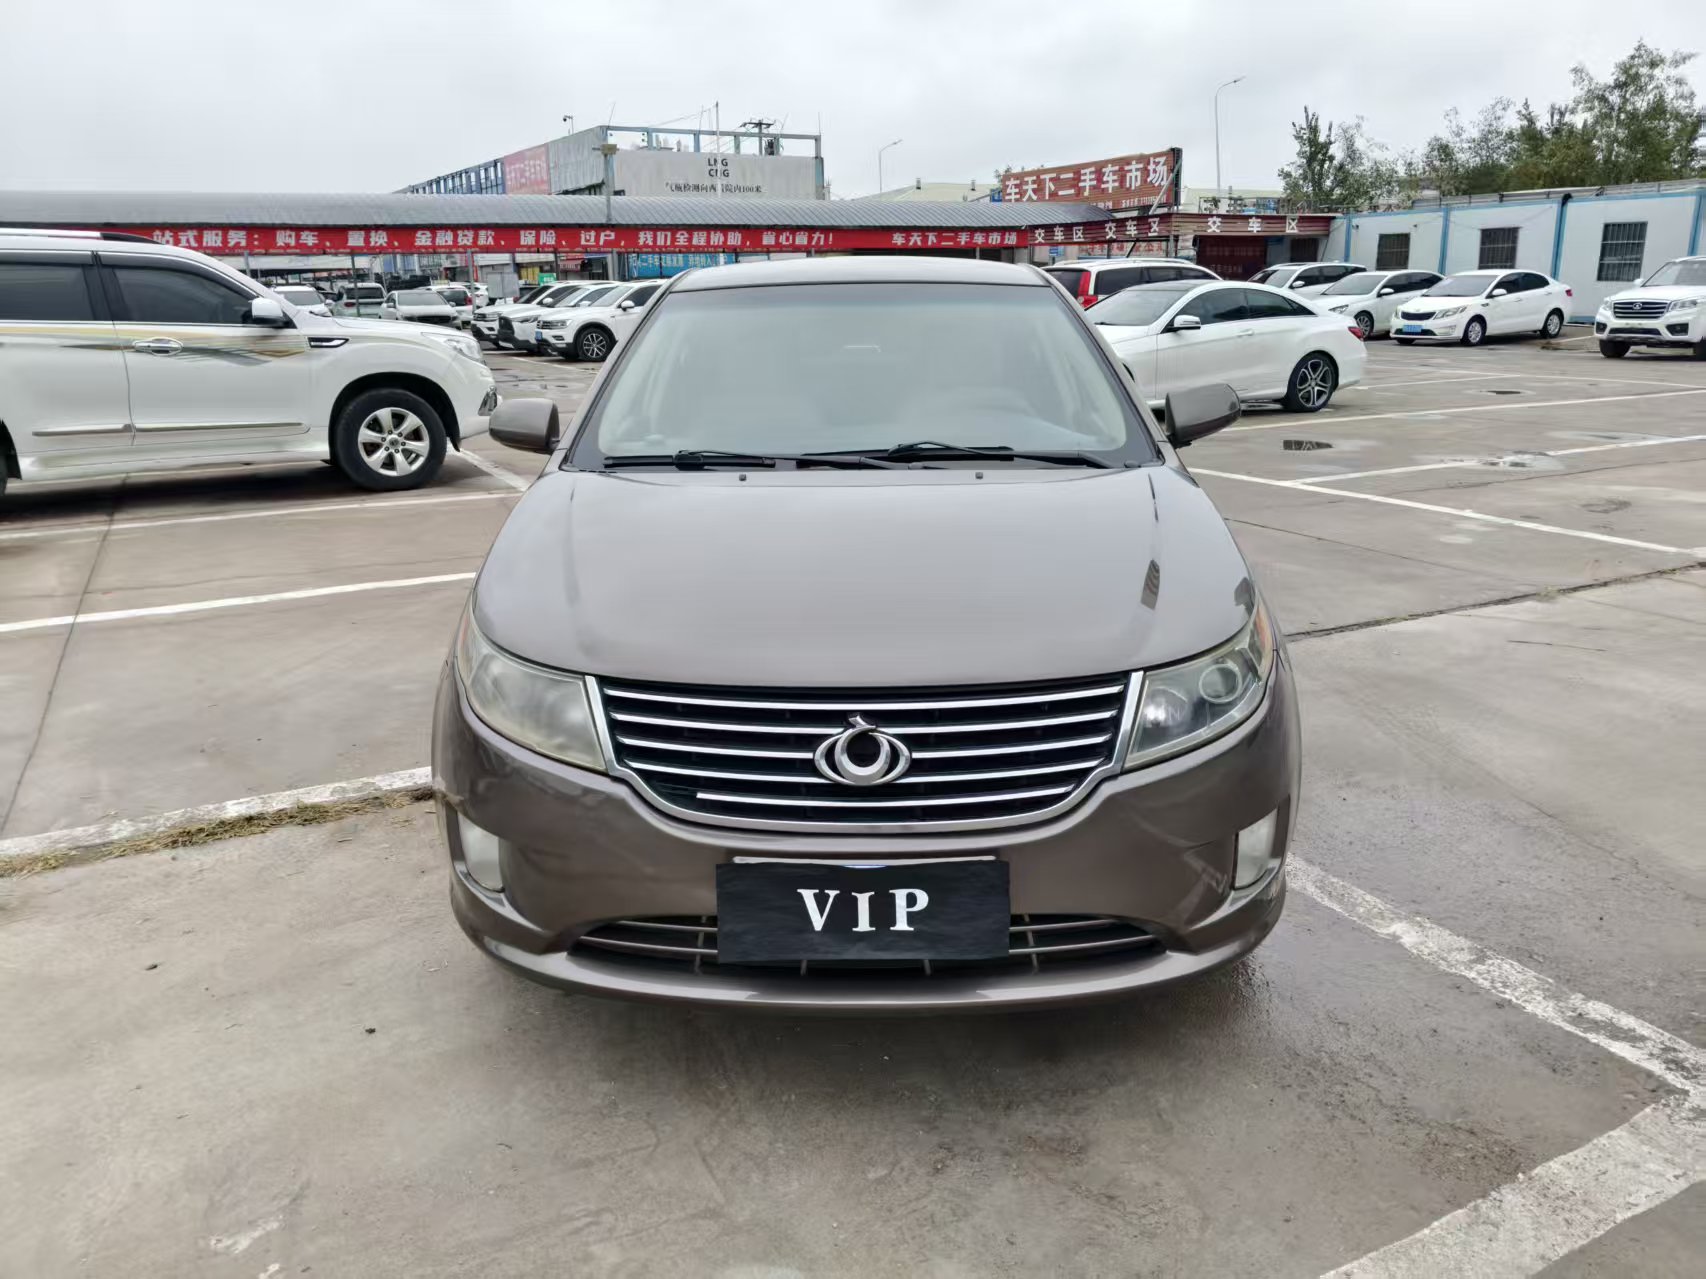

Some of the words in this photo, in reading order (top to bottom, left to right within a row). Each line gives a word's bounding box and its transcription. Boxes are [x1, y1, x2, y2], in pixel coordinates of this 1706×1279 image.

[1005, 156, 1168, 203] 车天下二手车市场
[1207, 216, 1299, 233] 交车区
[891, 232, 1017, 246] 车天下二手车市场
[1034, 225, 1084, 243] 交车区
[797, 888, 929, 932] VIP
